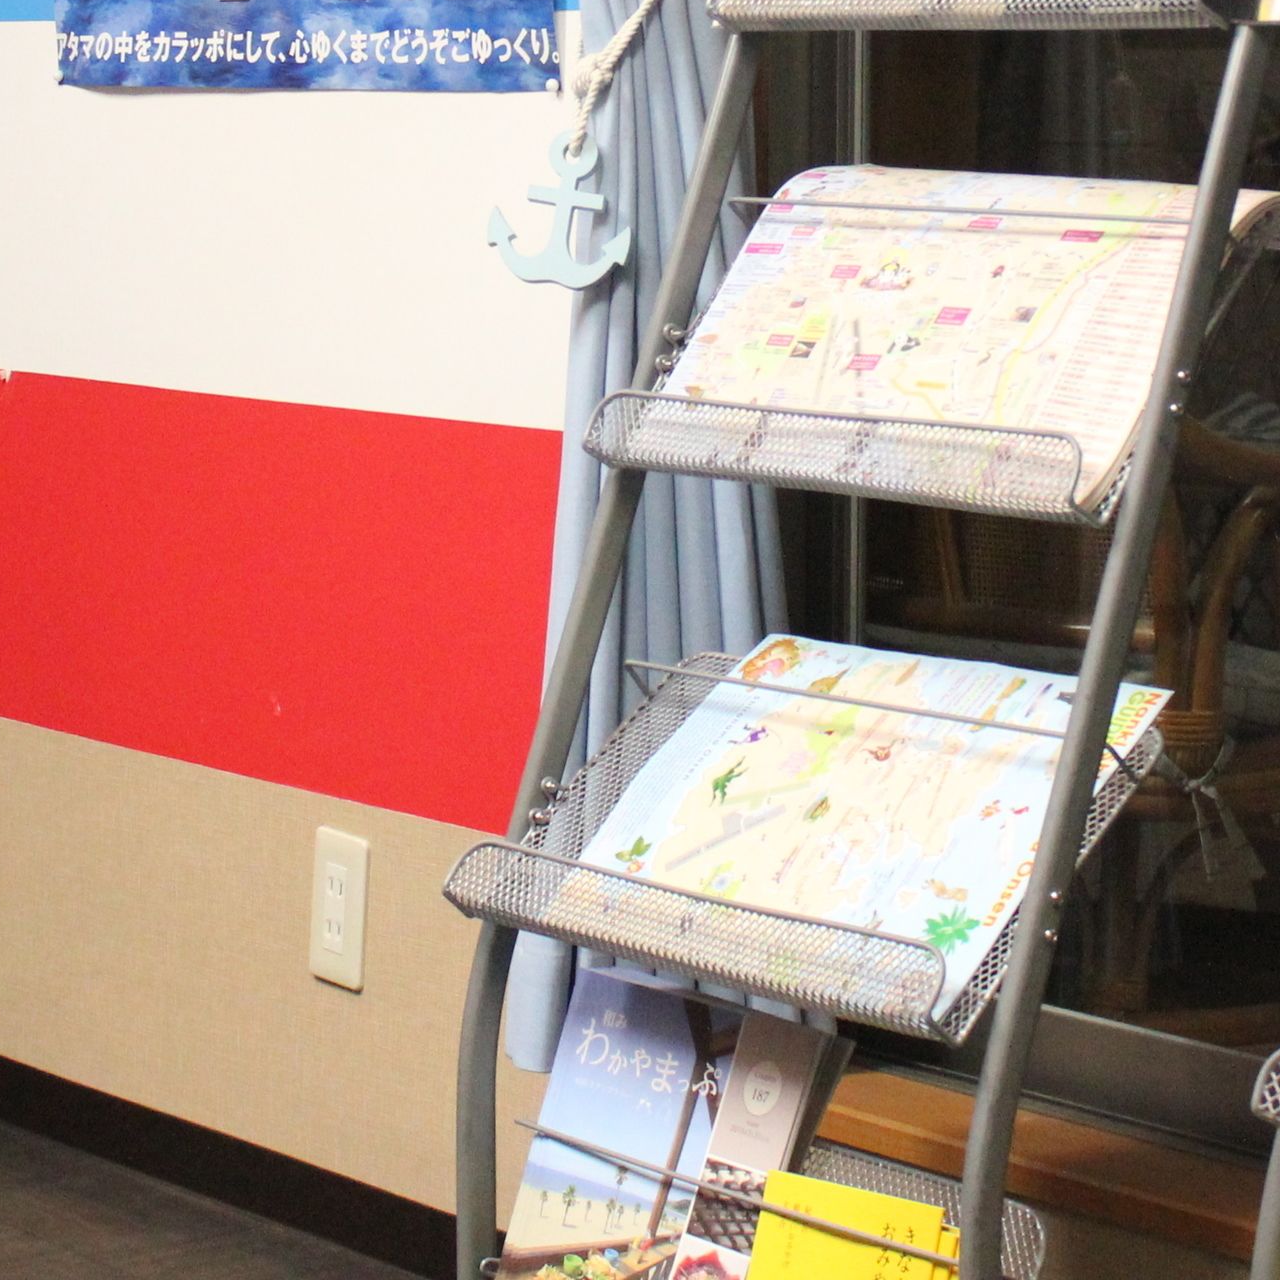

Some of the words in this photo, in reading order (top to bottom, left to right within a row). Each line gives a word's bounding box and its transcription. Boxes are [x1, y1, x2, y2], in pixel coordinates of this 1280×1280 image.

[55, 28, 560, 65] アタマの中をカラッポにして、心ゆくまでどうぞごゆっくり。
[1113, 692, 1163, 747] Nanki
[982, 861, 1034, 927] Onsen
[576, 1018, 723, 1097] わかやまっぷ
[751, 1086, 770, 1104] 187
